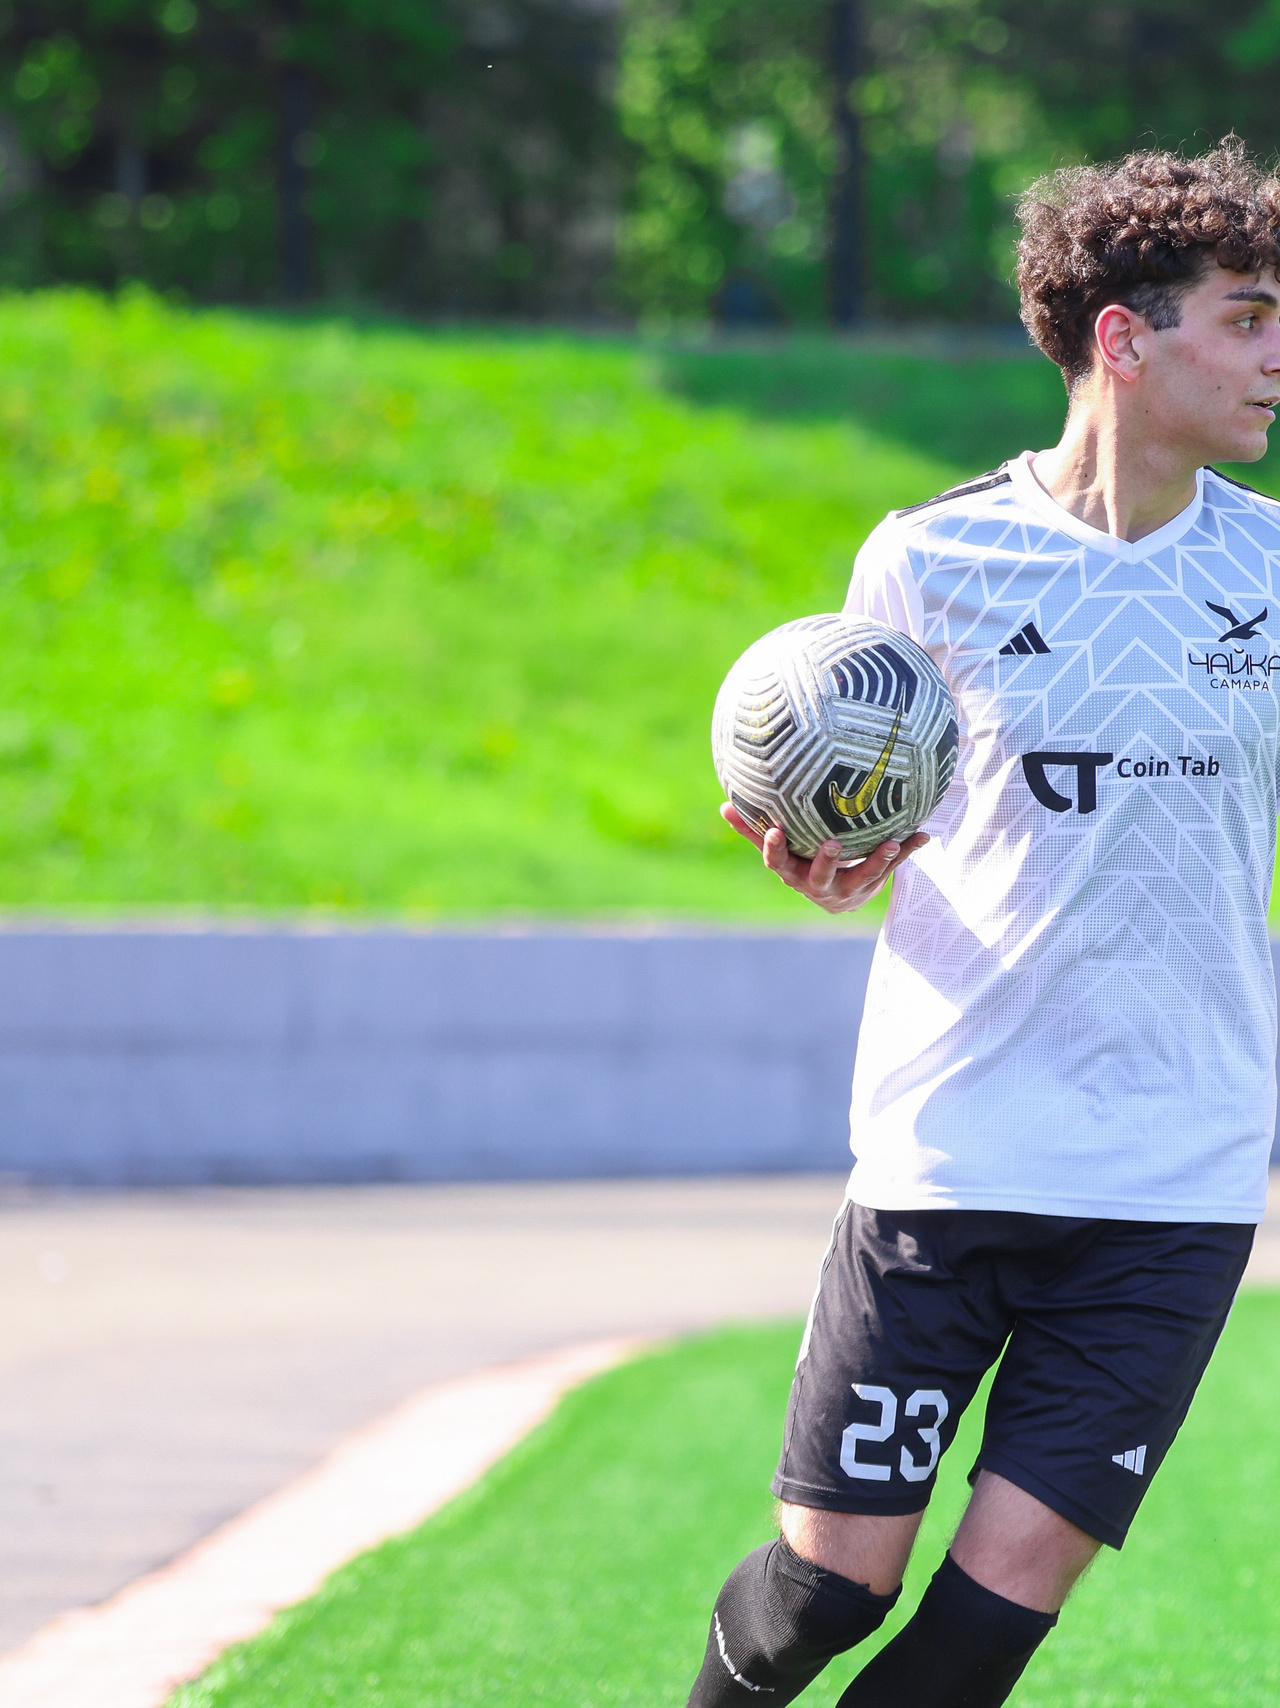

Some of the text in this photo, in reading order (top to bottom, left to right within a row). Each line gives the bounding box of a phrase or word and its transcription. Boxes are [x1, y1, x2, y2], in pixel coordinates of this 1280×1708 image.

[1210, 678, 1270, 691] САМАРА
[1117, 757, 1169, 778] Coin
[1178, 756, 1220, 777] Tab
[839, 1382, 949, 1483] 23
